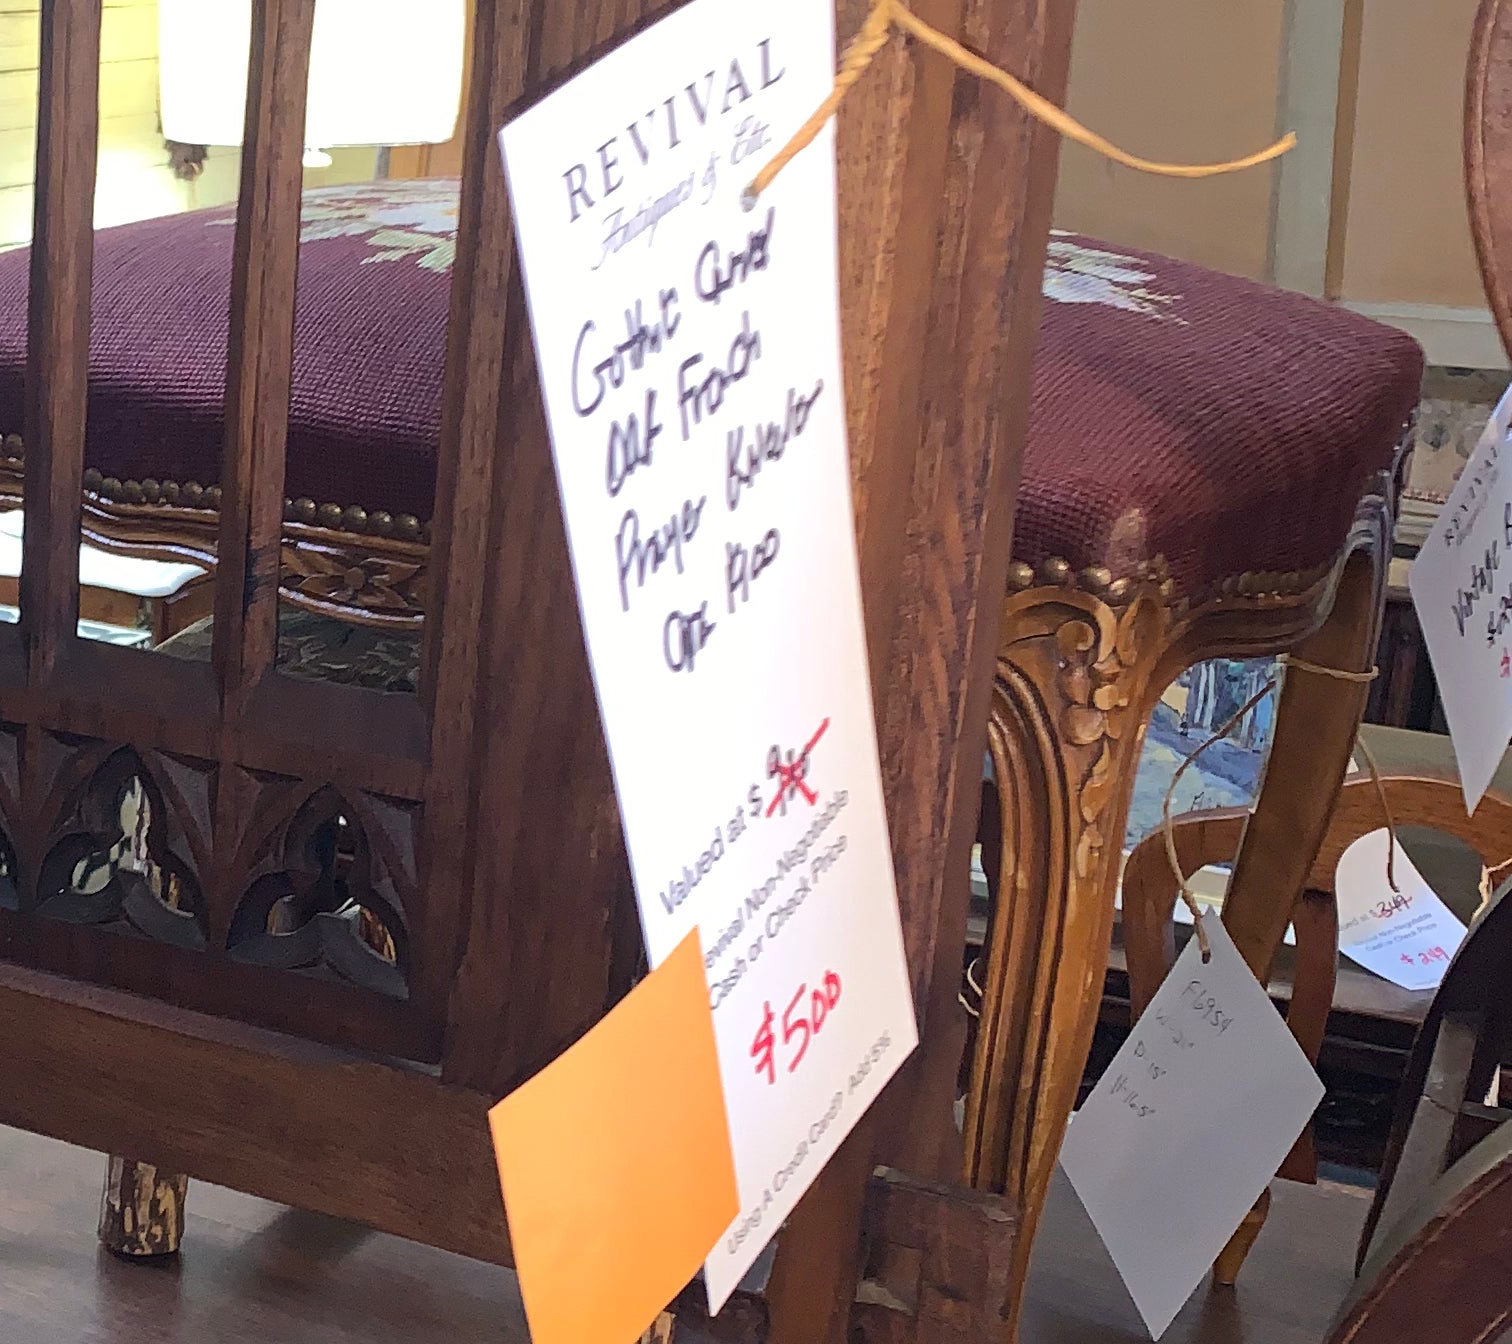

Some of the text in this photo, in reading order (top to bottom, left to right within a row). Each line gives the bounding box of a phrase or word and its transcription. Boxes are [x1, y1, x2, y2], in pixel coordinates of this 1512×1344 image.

[562, 38, 786, 223] REVIVAL
[659, 826, 725, 915] Valued
[727, 805, 747, 843] at
[704, 907, 745, 968] evival
[710, 956, 747, 1010] Cash
[765, 876, 812, 939] Check
[749, 970, 842, 1085] $500
